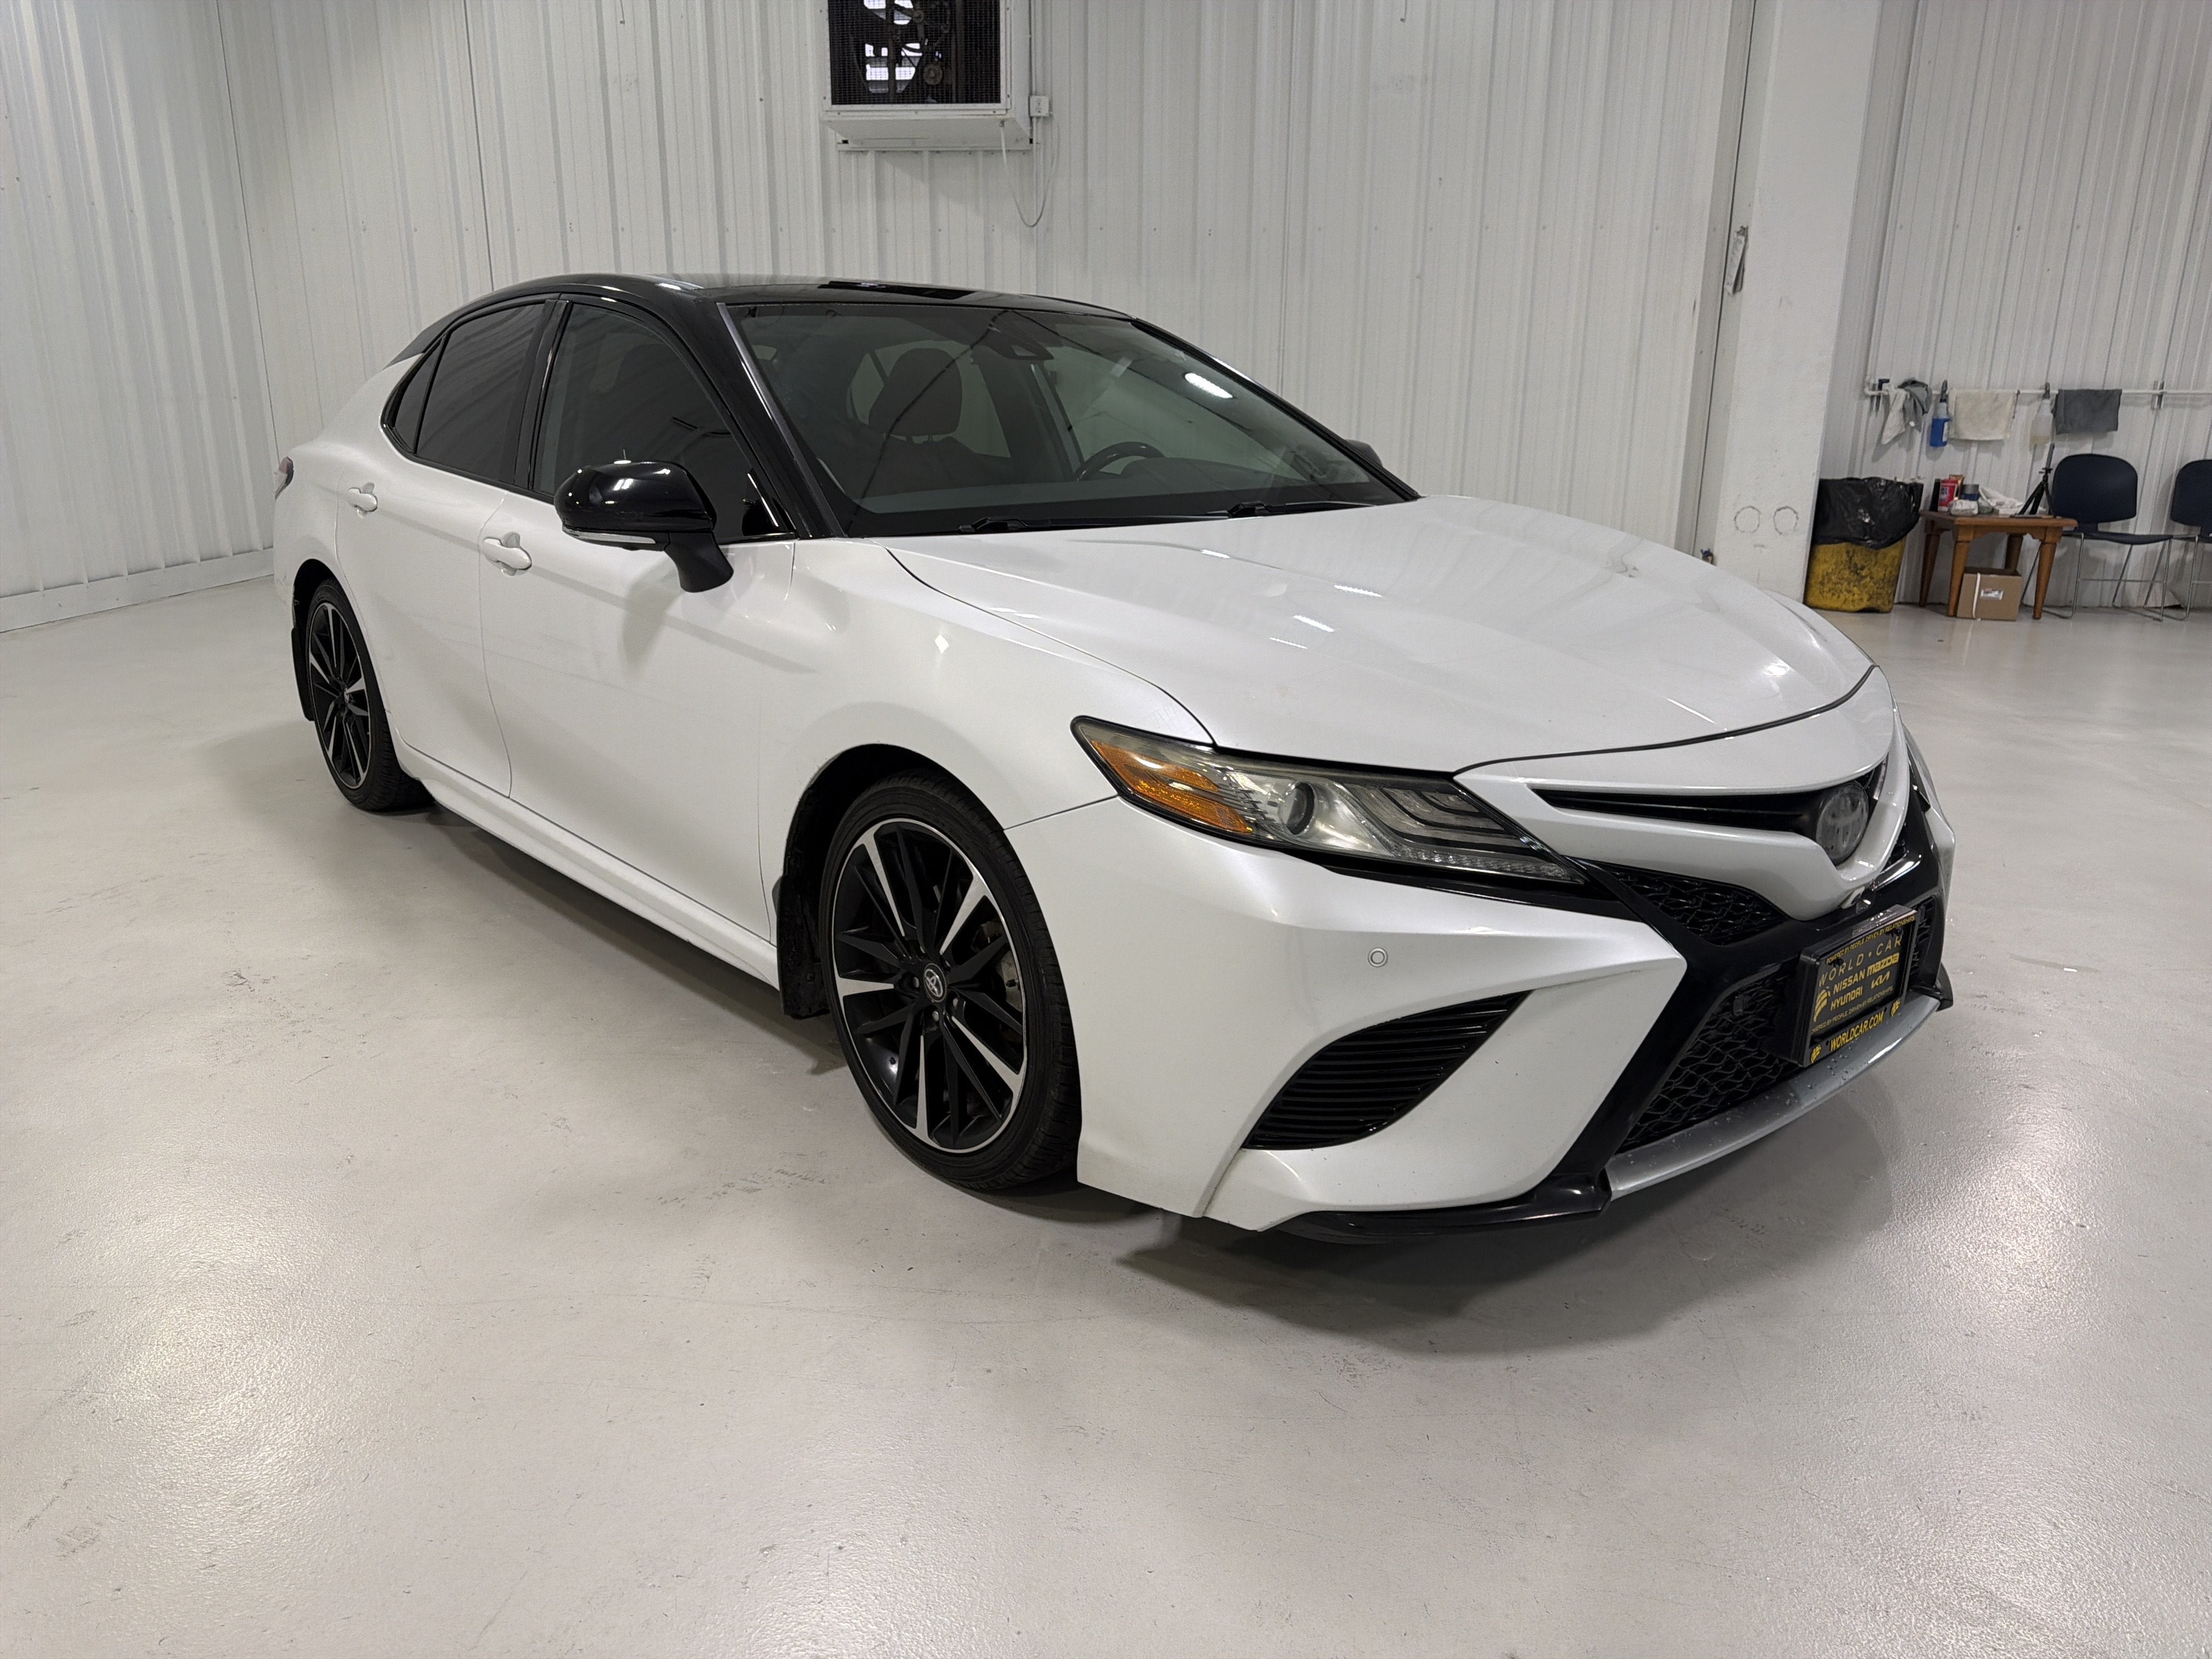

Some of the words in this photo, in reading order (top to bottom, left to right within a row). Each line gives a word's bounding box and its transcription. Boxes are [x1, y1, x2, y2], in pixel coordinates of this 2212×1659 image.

[1865, 932, 1880, 943] DRIVEN
[1885, 915, 1915, 933] RELATIONSHIPS
[1819, 953, 1864, 988] WORLD
[1876, 934, 1903, 956] CAR
[1833, 968, 1866, 995] NISSAN
[1866, 952, 1900, 977] mazda
[1830, 985, 1863, 1011] HYUNDAI
[1848, 1005, 1862, 1014] DRIVEN
[1867, 985, 1894, 1003] RELATIONSHIPS
[1830, 1011, 1884, 1052] WORLDCAR.COM
